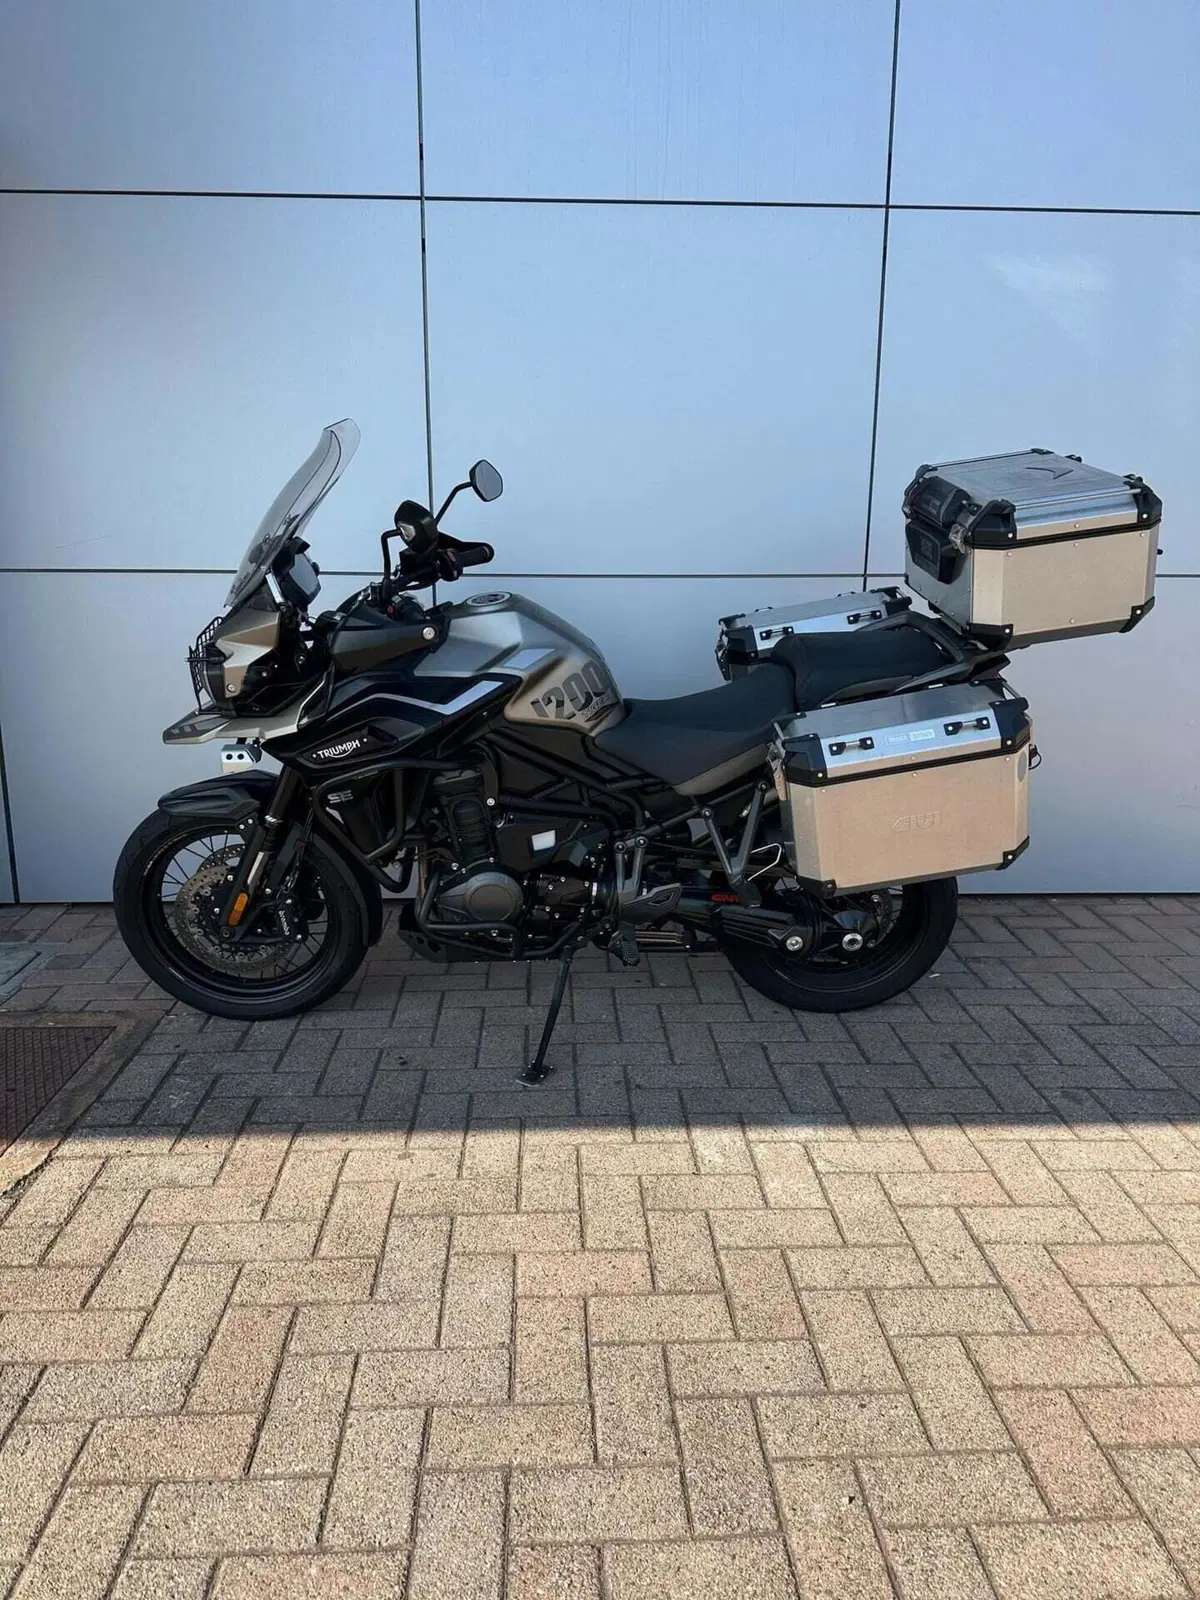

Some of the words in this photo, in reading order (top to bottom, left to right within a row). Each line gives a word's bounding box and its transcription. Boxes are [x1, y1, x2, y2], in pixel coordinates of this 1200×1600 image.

[530, 660, 611, 720] 1200
[317, 739, 361, 759] TRIUMPH
[327, 789, 354, 804] SE
